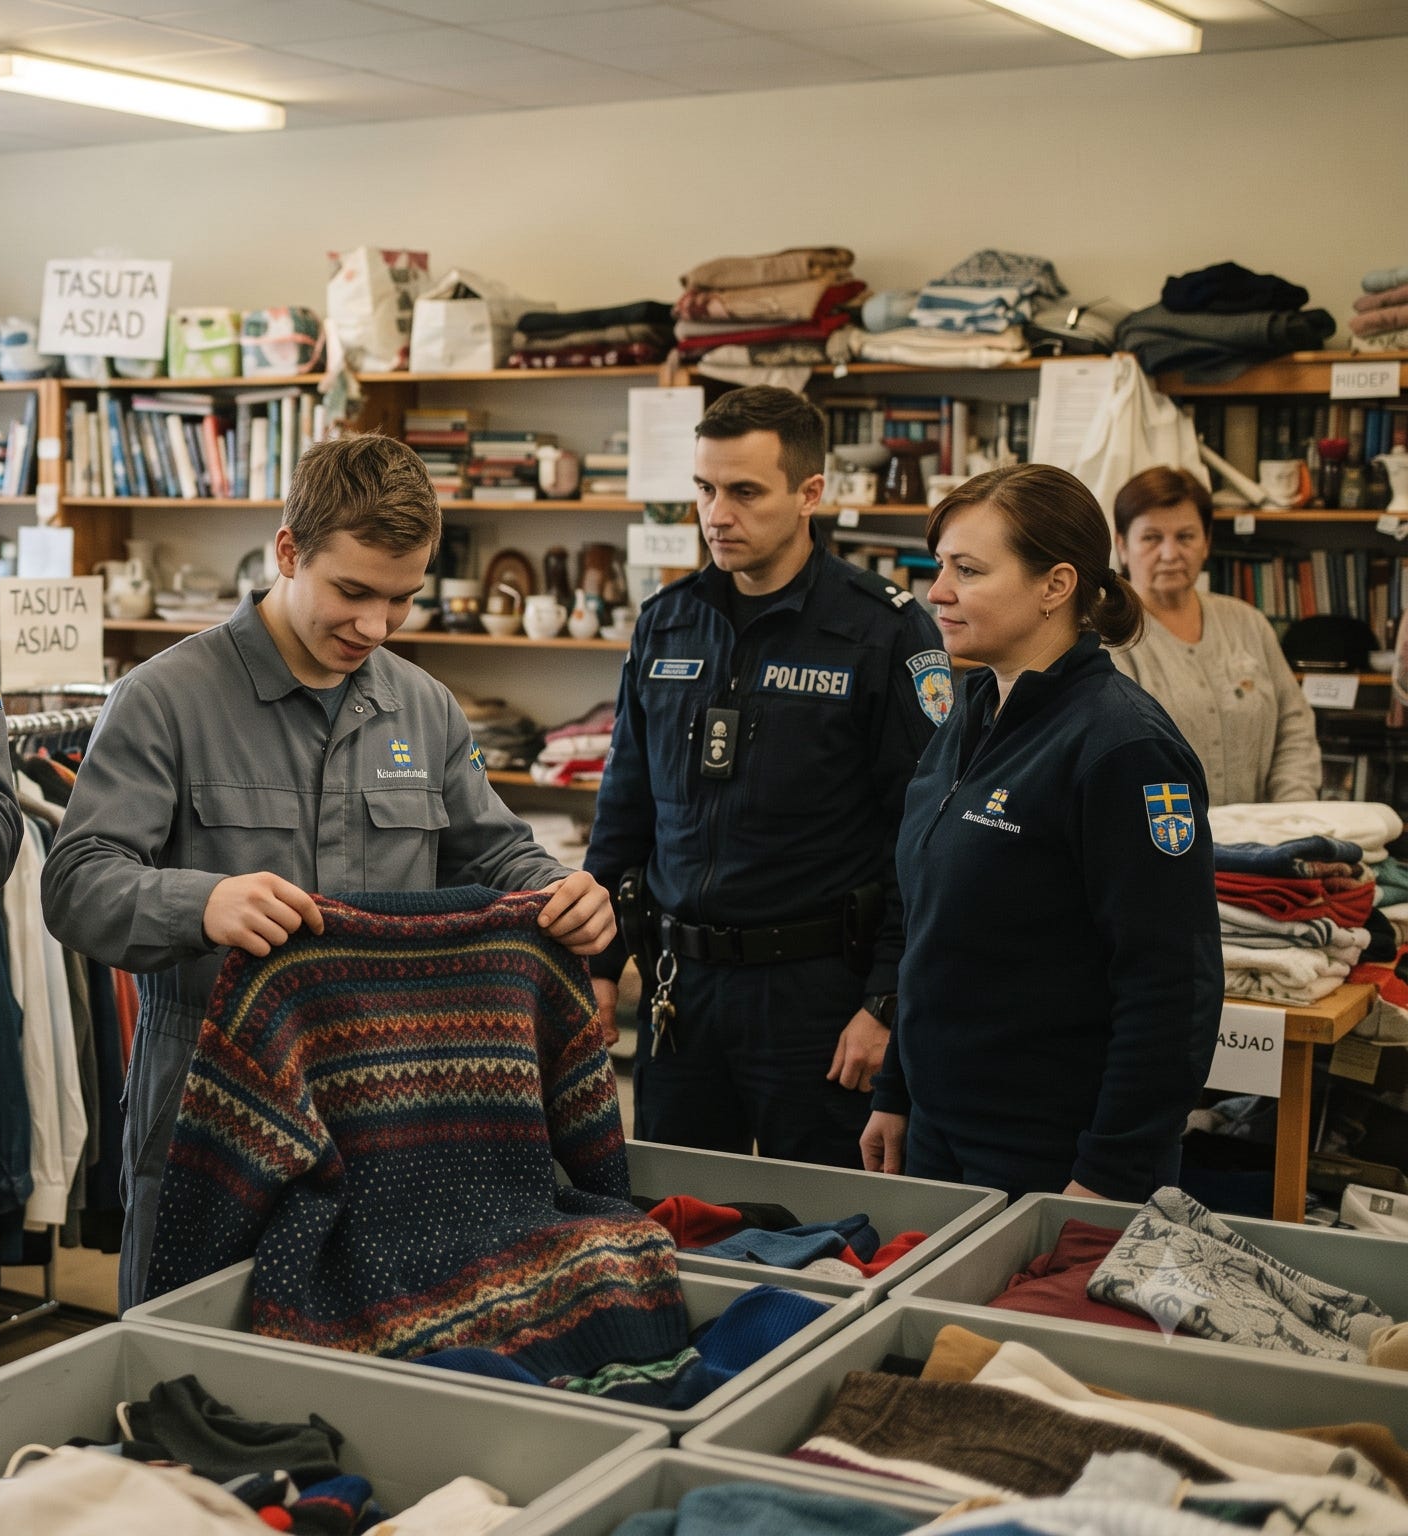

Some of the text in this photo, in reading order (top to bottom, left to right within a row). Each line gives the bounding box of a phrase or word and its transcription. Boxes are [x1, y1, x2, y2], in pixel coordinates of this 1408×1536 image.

[54, 269, 158, 299] TASUTA
[10, 587, 88, 615] TASUTA
[763, 665, 849, 695] POLITSEI
